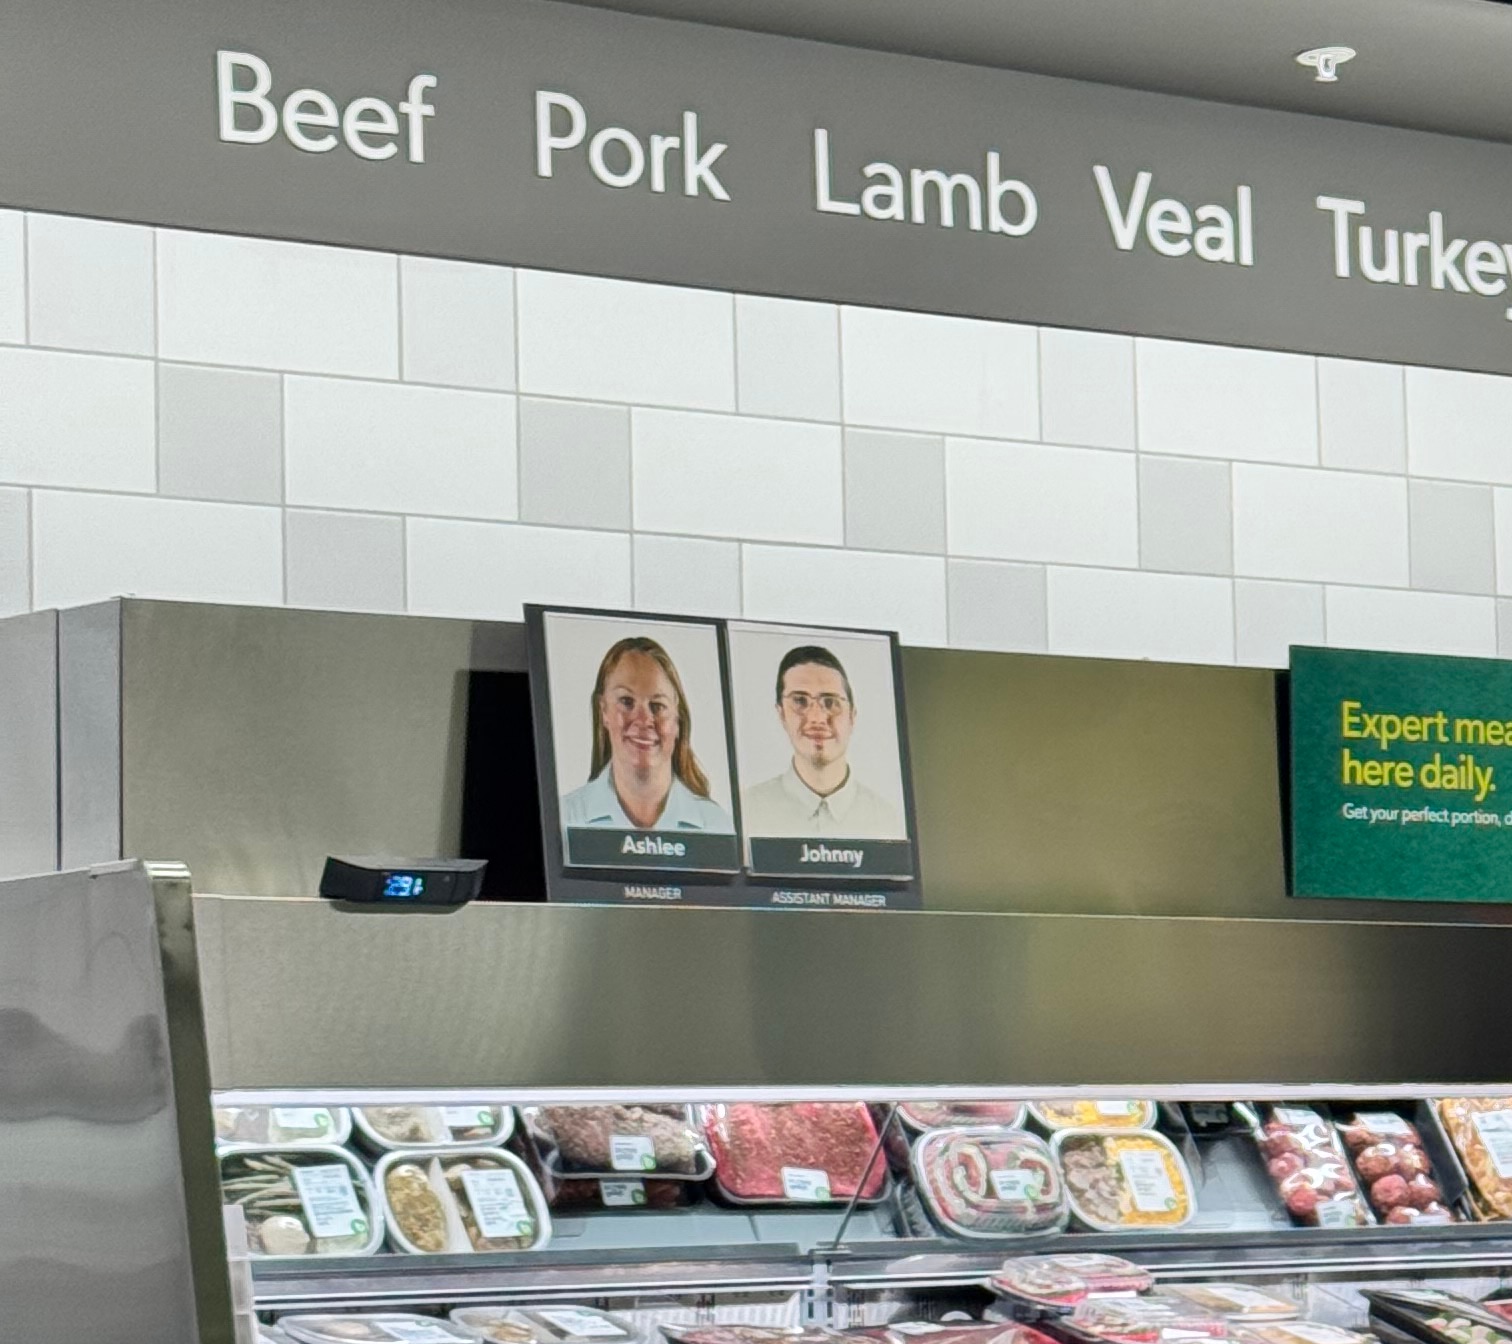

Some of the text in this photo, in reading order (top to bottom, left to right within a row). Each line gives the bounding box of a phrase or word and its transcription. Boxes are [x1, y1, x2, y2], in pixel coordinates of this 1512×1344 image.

[216, 49, 438, 164] Beef
[535, 90, 731, 202] Pork
[813, 127, 1038, 237] Lamb
[1092, 165, 1254, 267] Veal
[1341, 700, 1449, 749] Expert
[1342, 748, 1496, 802] here daily.
[1342, 802, 1367, 822] Get
[1369, 807, 1400, 825] your
[1401, 805, 1450, 827] perfect
[1451, 809, 1502, 829] portion,
[622, 835, 685, 857] Ashlee
[799, 843, 864, 868] Johnny
[624, 886, 682, 901] MANAGER
[772, 890, 886, 908] ASSISTANT MANAGER
